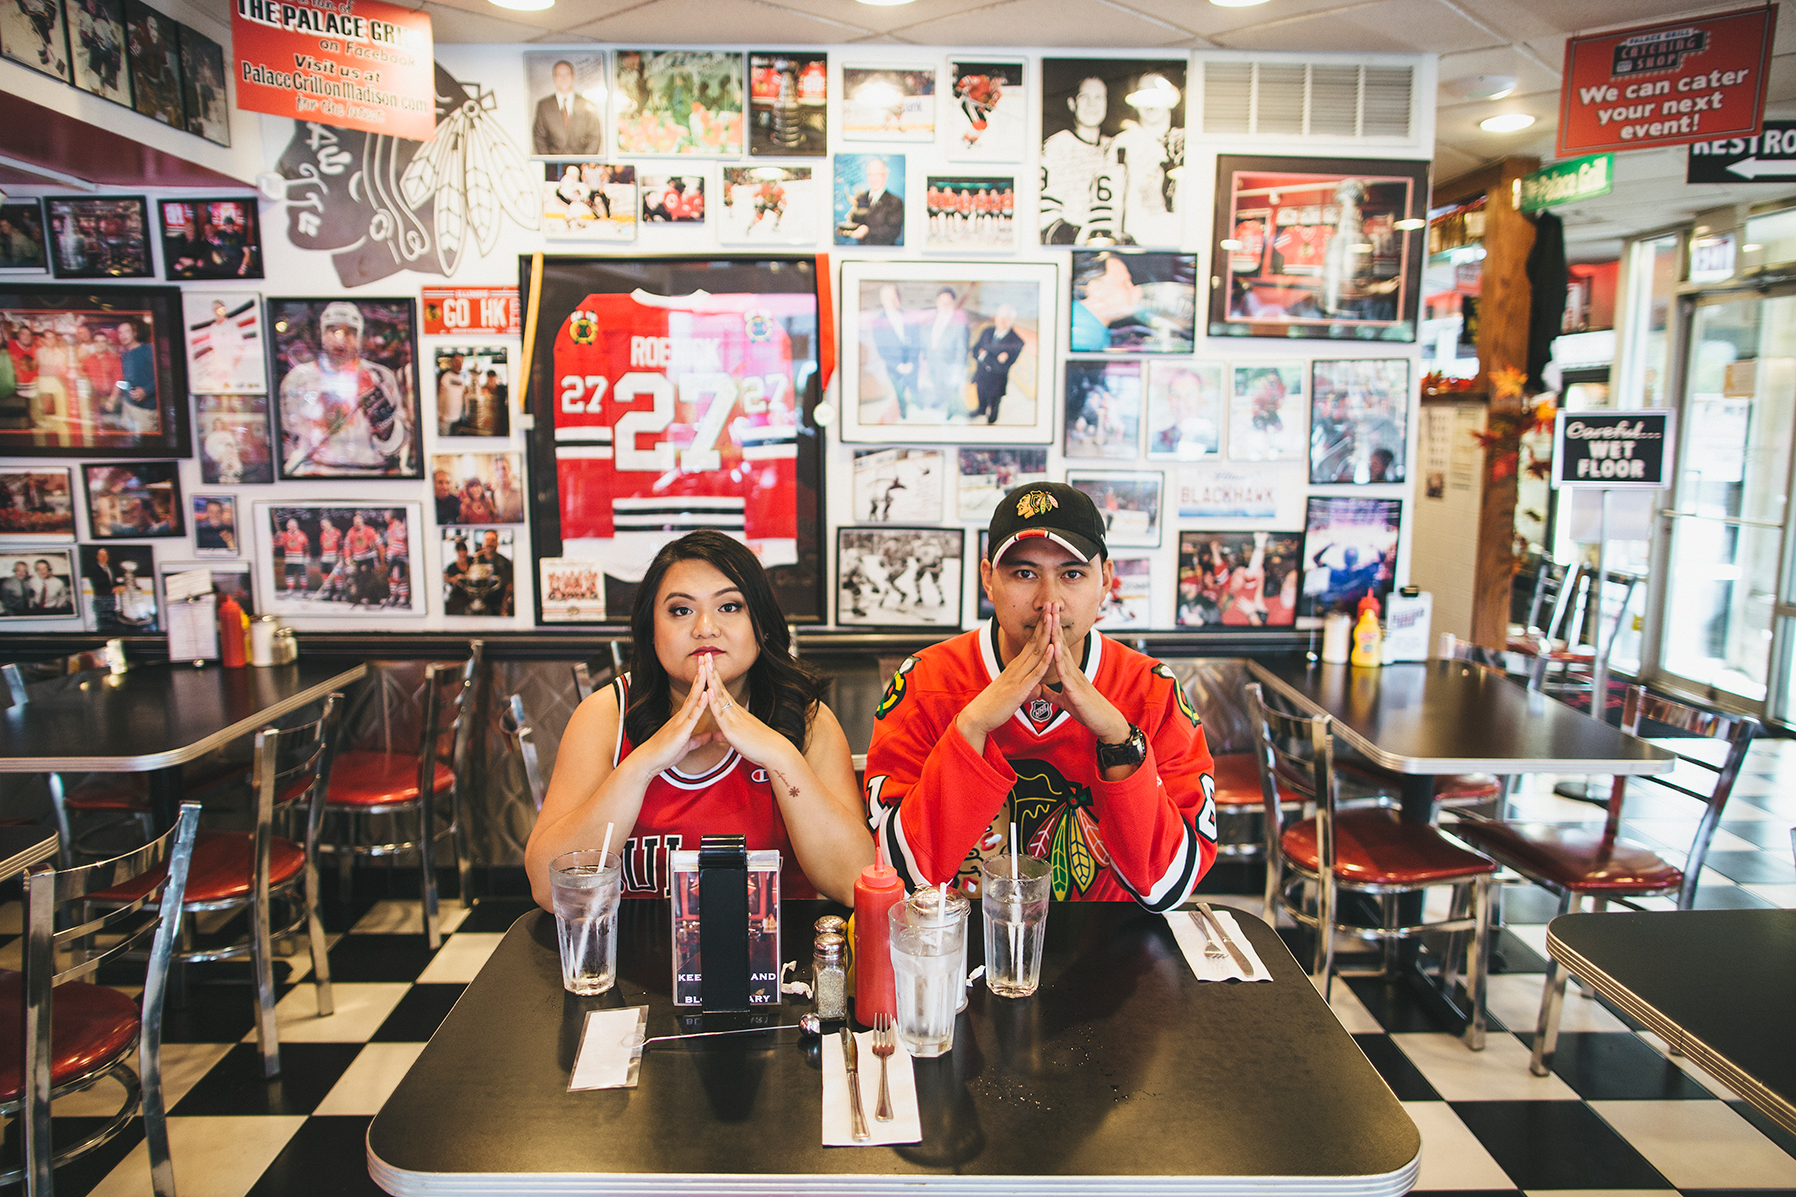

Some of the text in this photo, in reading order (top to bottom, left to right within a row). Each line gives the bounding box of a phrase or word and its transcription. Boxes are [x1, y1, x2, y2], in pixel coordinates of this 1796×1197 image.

[282, 3, 366, 40] PALACE
[369, 18, 423, 50] GRI
[319, 39, 416, 68] on Facebook
[1622, 38, 1697, 59] CATERING
[1637, 54, 1677, 70] SHOP
[293, 53, 382, 84] Visit us at
[1580, 68, 1749, 105] We can cater
[296, 95, 317, 112] for
[321, 99, 345, 116] the
[1598, 91, 1725, 126] your next
[1619, 115, 1700, 141] event!
[442, 298, 470, 328] GO
[561, 375, 609, 414] 27
[742, 373, 789, 413] 27
[613, 371, 739, 471] 27
[1566, 420, 1661, 440] Careful...
[1588, 440, 1637, 459] WET
[1577, 459, 1645, 479] FLOOR
[677, 972, 777, 982] KEE AND
[748, 994, 771, 1003] ARY
